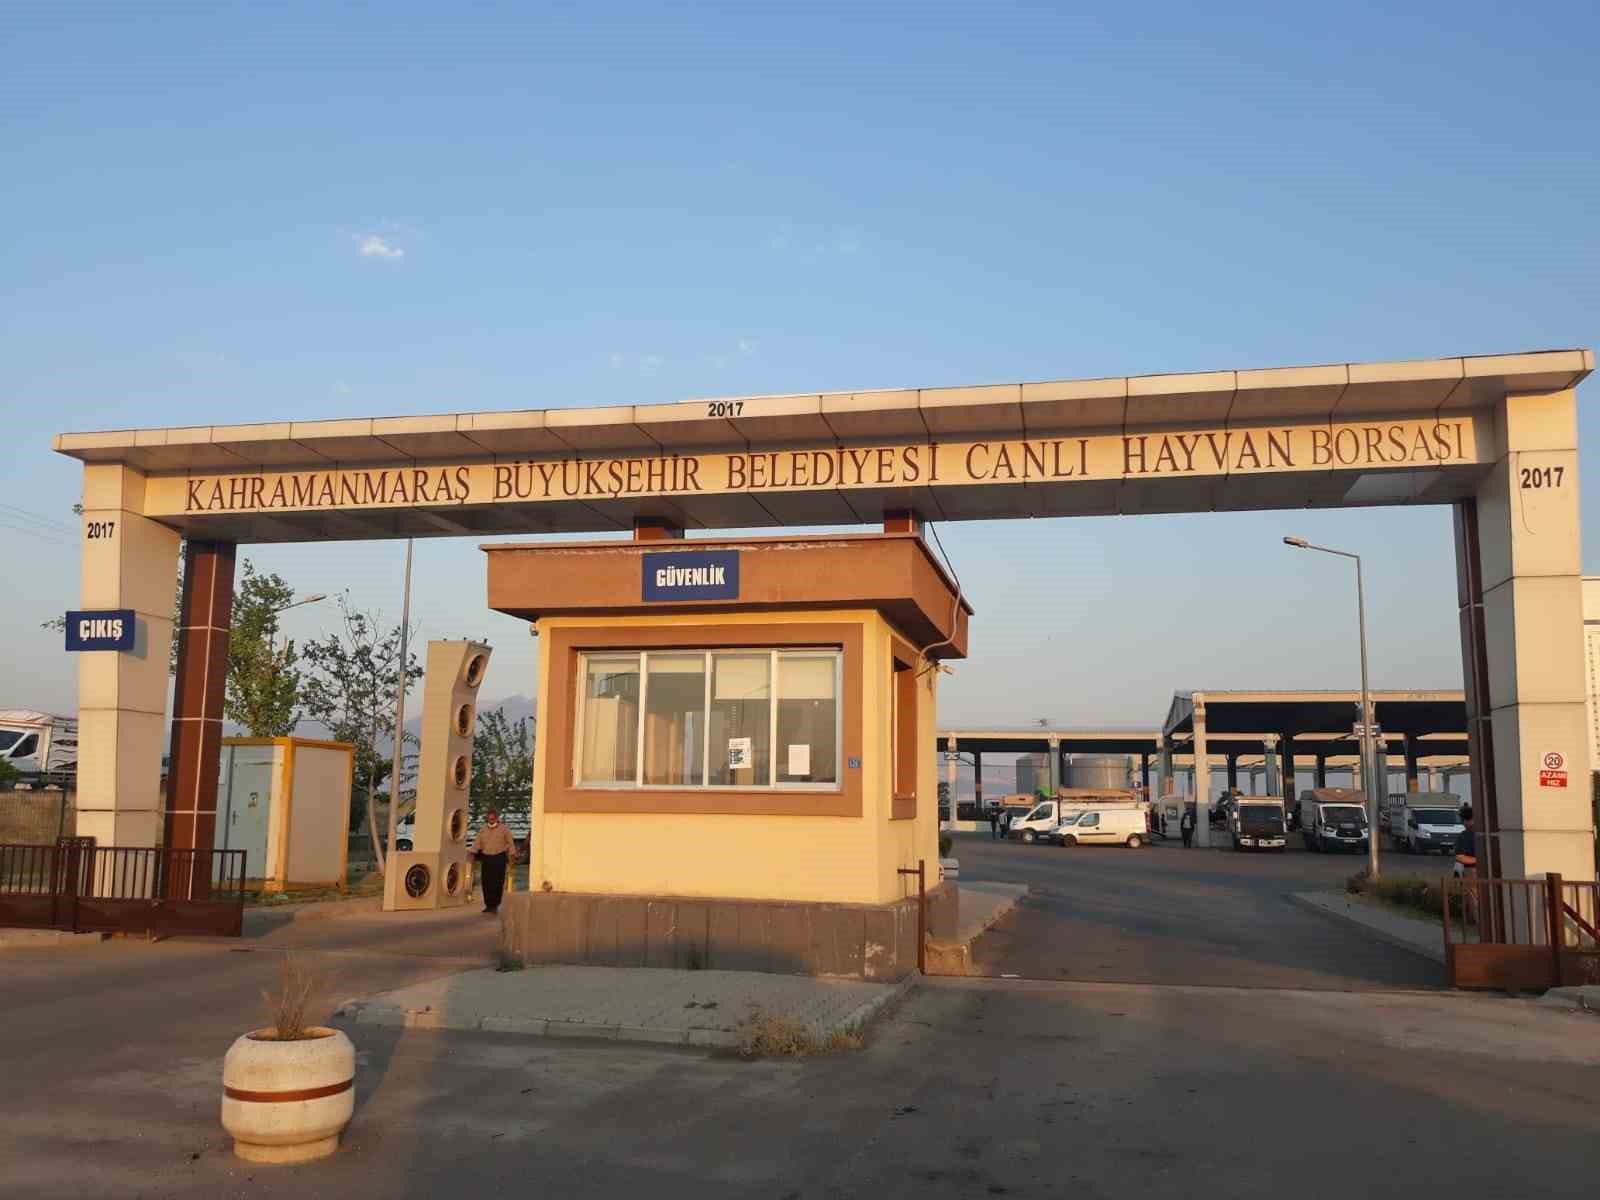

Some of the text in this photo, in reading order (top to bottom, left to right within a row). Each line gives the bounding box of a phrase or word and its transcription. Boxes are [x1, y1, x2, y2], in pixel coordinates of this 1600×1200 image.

[708, 402, 744, 420] 2017
[185, 422, 1465, 512] KAHRAMANMARAŞ BÜYÜKŞEHİR BELEDİYESİ CANLI HAYVAN BORSASI
[1521, 467, 1565, 489] 2017
[87, 522, 115, 539] 2017
[656, 564, 726, 587] GÜVENLİK
[79, 619, 123, 641] ÇIKIŞ
